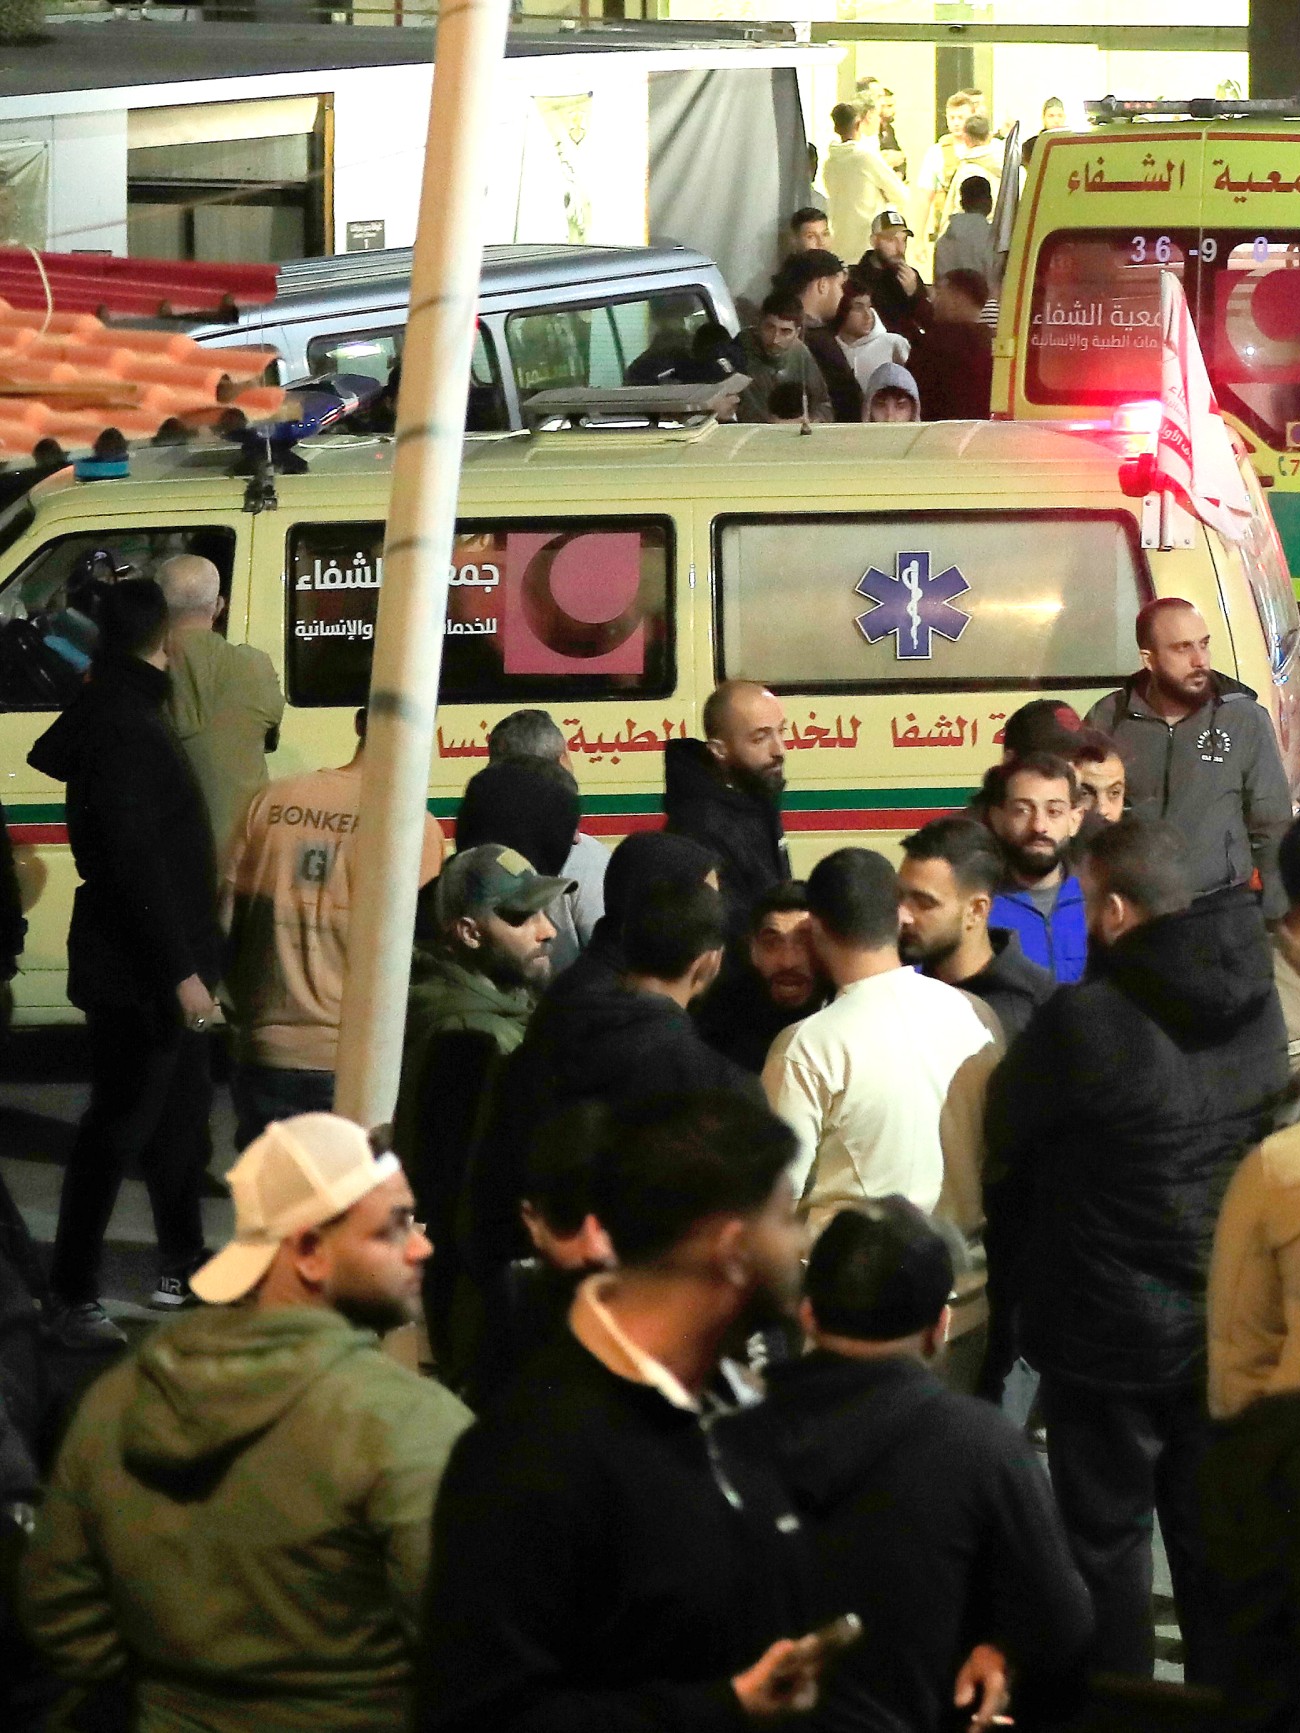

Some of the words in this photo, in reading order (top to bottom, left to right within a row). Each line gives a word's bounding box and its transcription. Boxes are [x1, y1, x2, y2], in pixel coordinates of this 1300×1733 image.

[1066, 152, 1185, 196] الشفاء
[1032, 300, 1103, 326] الشفاء
[1110, 305, 1162, 331] معية
[294, 551, 384, 592] لشفاء
[294, 618, 374, 641] والإنسانية
